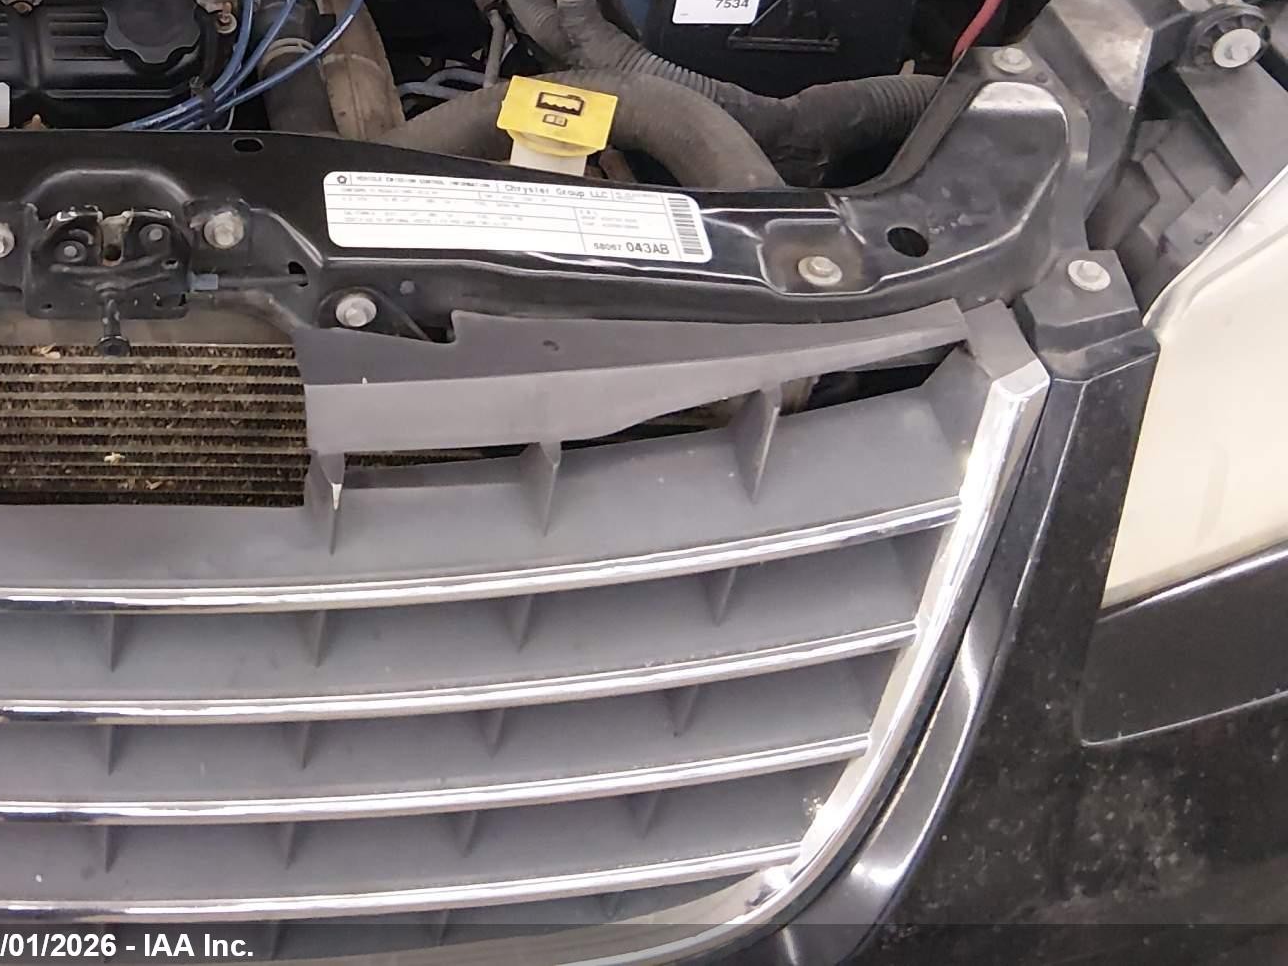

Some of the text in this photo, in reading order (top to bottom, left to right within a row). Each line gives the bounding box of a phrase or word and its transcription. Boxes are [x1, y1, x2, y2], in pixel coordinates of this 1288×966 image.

[504, 184, 550, 195] Chrysler
[555, 188, 585, 199] Group
[590, 190, 609, 199] LLC
[625, 241, 670, 255] 043AB
